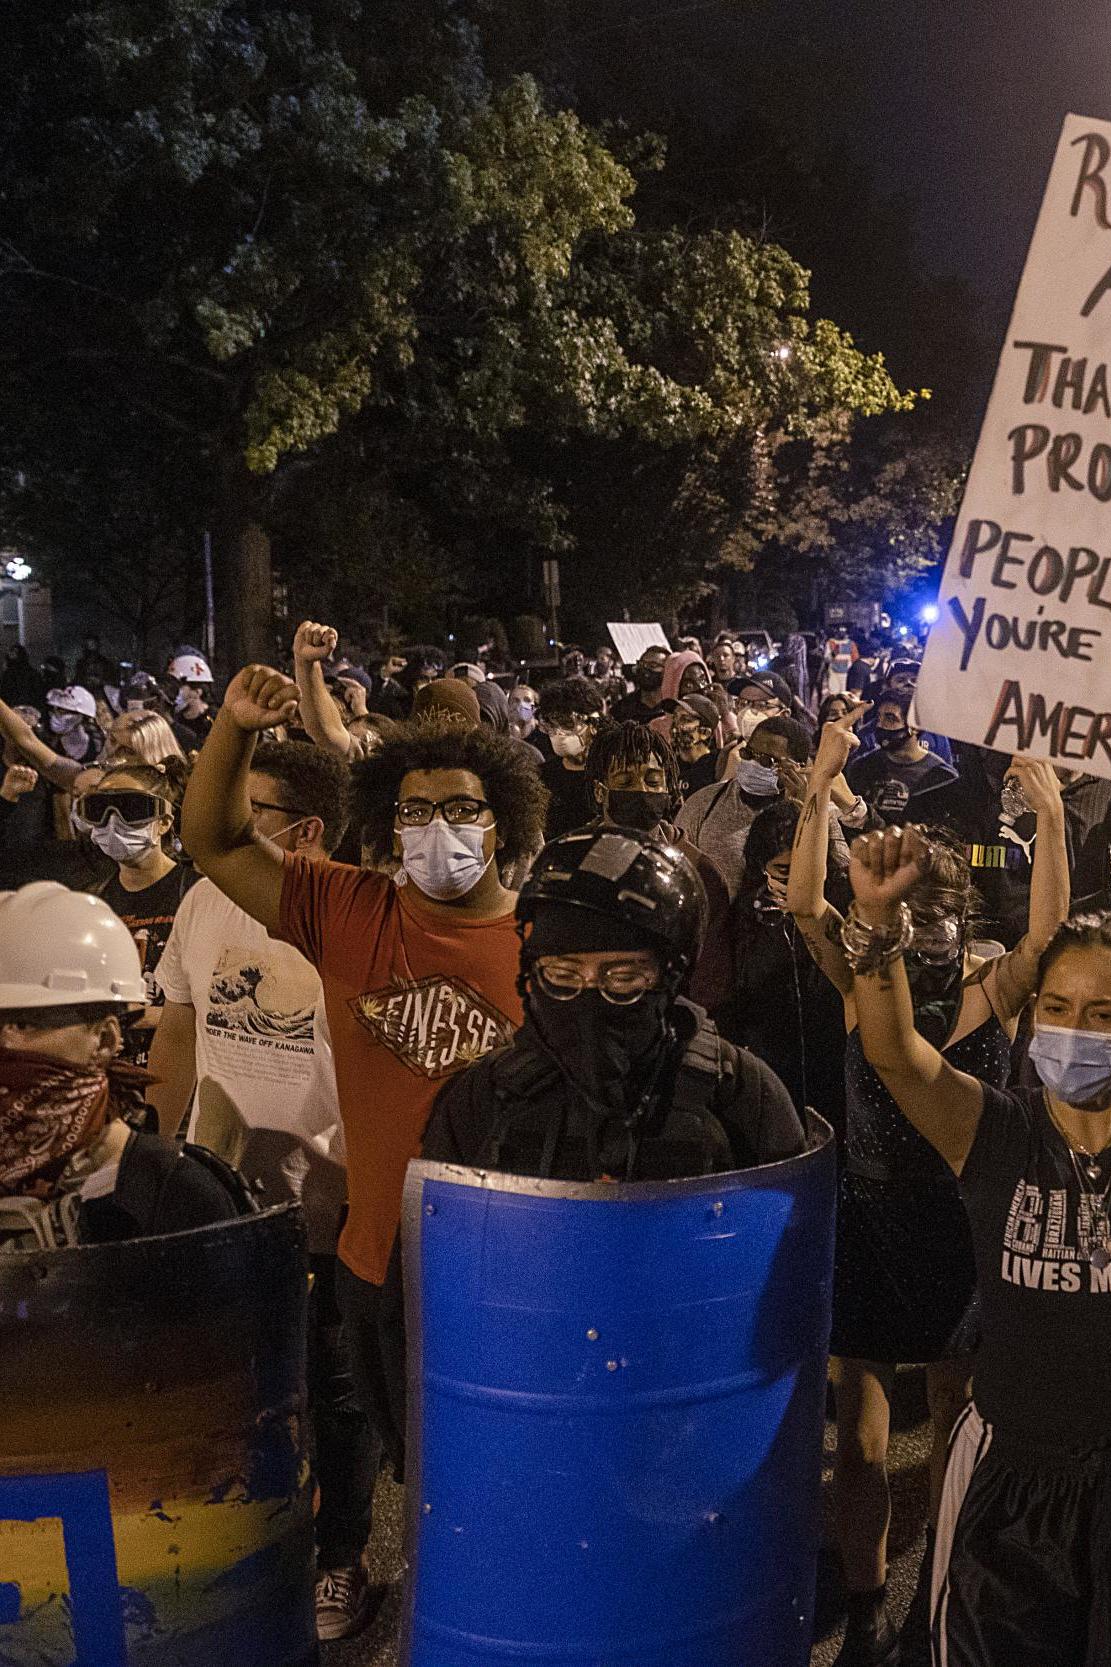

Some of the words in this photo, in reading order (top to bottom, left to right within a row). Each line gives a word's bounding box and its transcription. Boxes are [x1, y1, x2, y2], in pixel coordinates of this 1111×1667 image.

[224, 1031, 236, 1041] THE
[239, 1035, 256, 1045] WAVE
[258, 1039, 273, 1049] OFF
[275, 1042, 315, 1055] KANAGAWA
[1042, 1247, 1076, 1259] HAITIAN
[1001, 1250, 1081, 1293] LIVES
